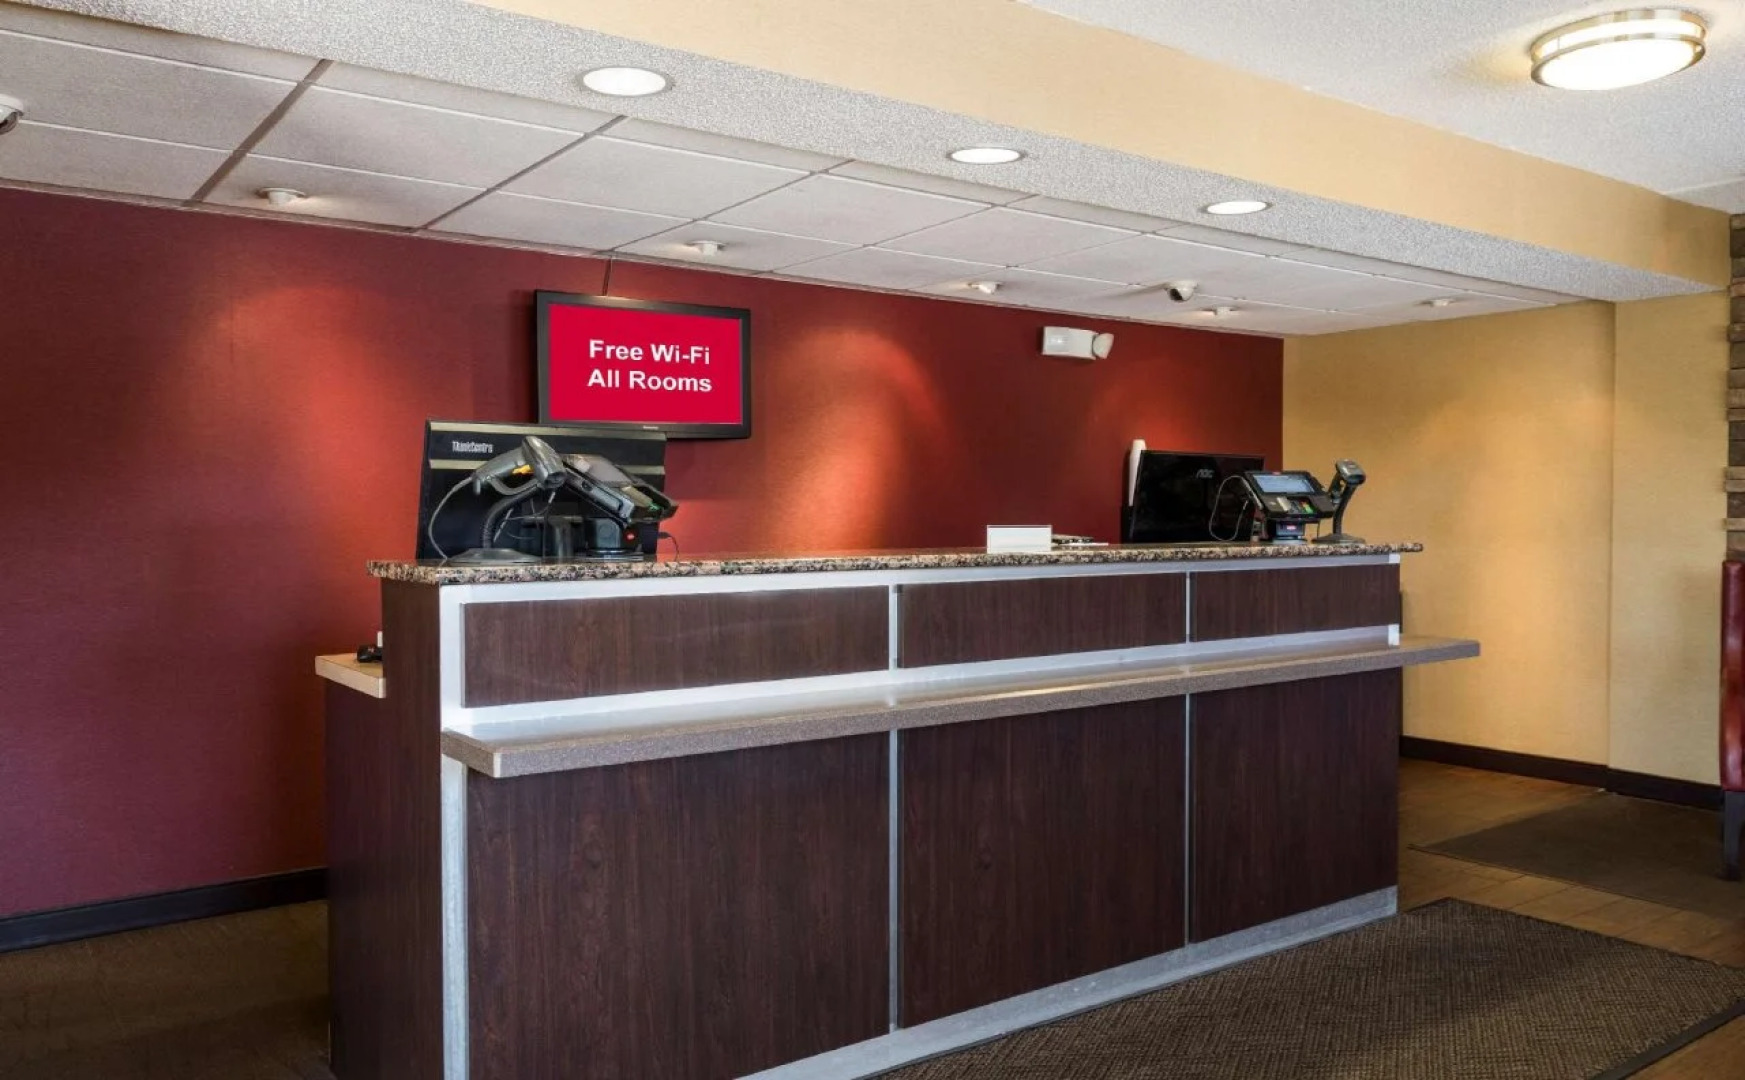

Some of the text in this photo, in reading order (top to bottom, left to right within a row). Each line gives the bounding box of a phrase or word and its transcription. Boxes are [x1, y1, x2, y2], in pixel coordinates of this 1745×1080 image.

[589, 339, 710, 365] Free Wi-Fi
[587, 368, 712, 392] All Rooms
